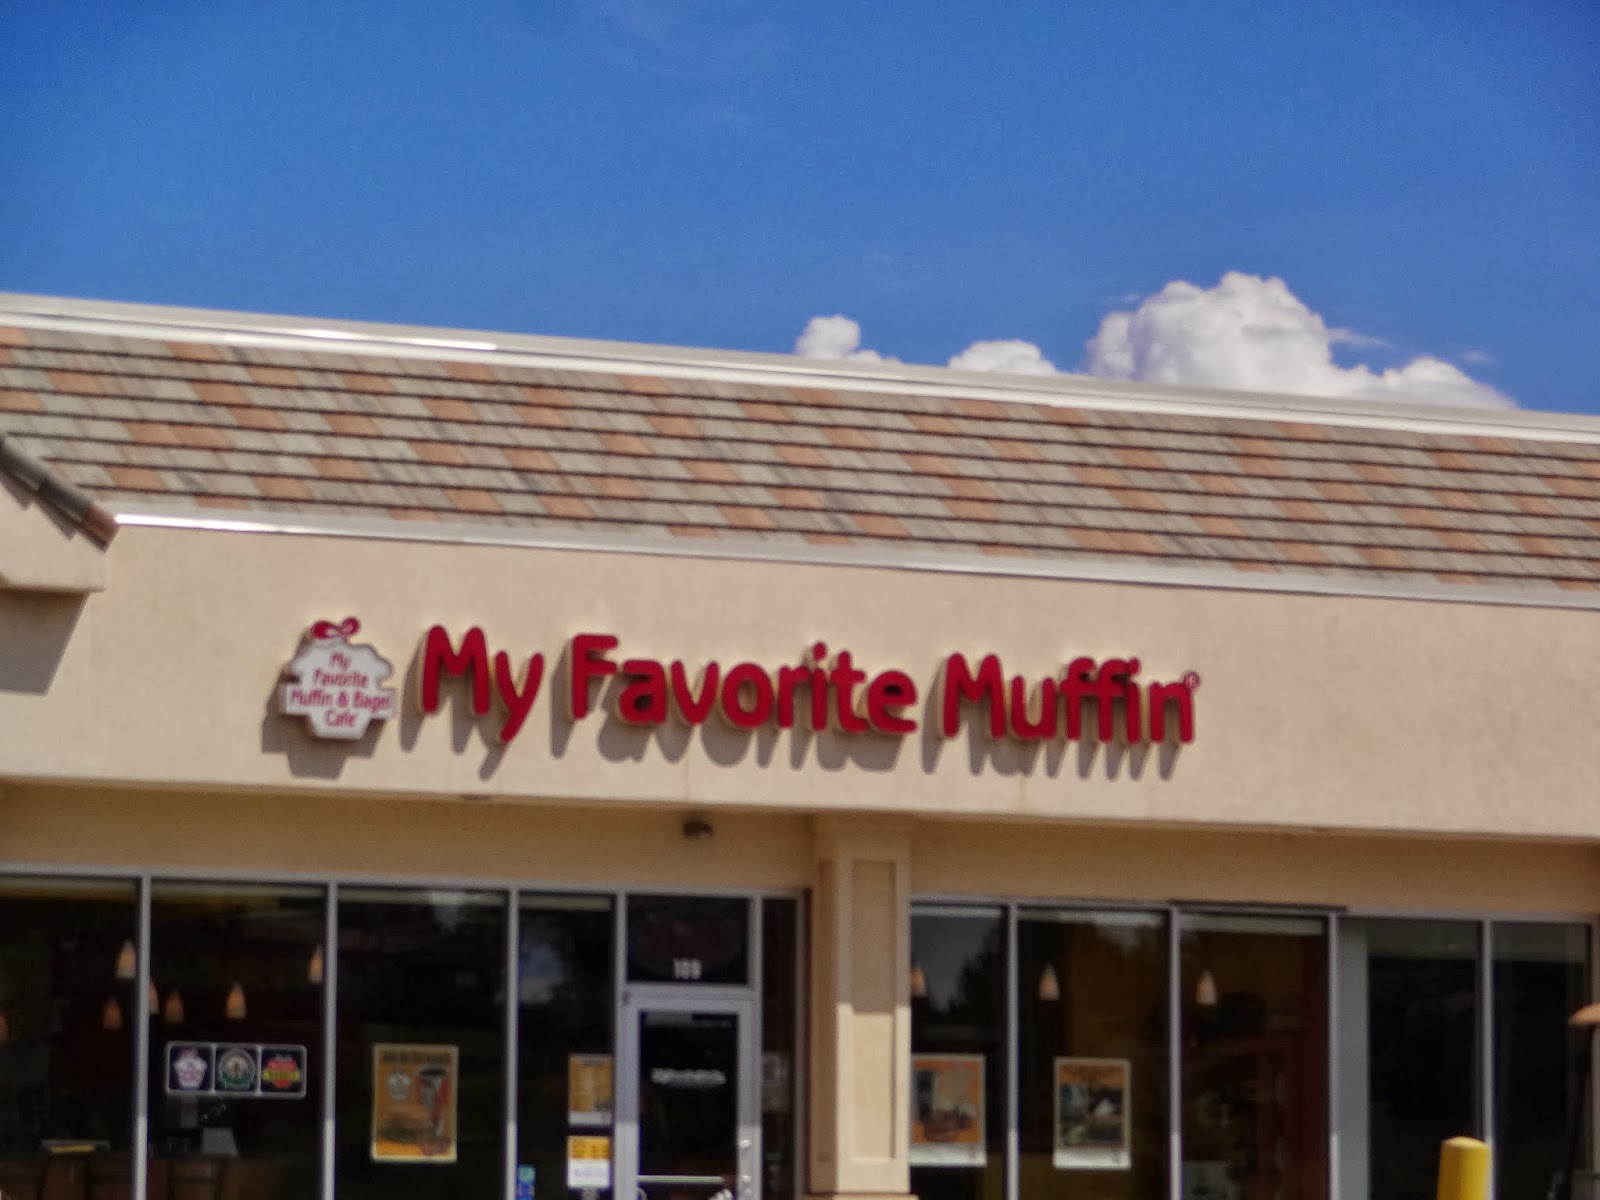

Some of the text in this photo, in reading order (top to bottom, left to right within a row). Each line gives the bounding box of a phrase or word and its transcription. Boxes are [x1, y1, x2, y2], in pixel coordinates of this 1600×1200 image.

[330, 652, 351, 670] My
[313, 668, 368, 687] Favorite
[420, 624, 1195, 745] My Favorite Muffin
[291, 689, 333, 707] Muffin
